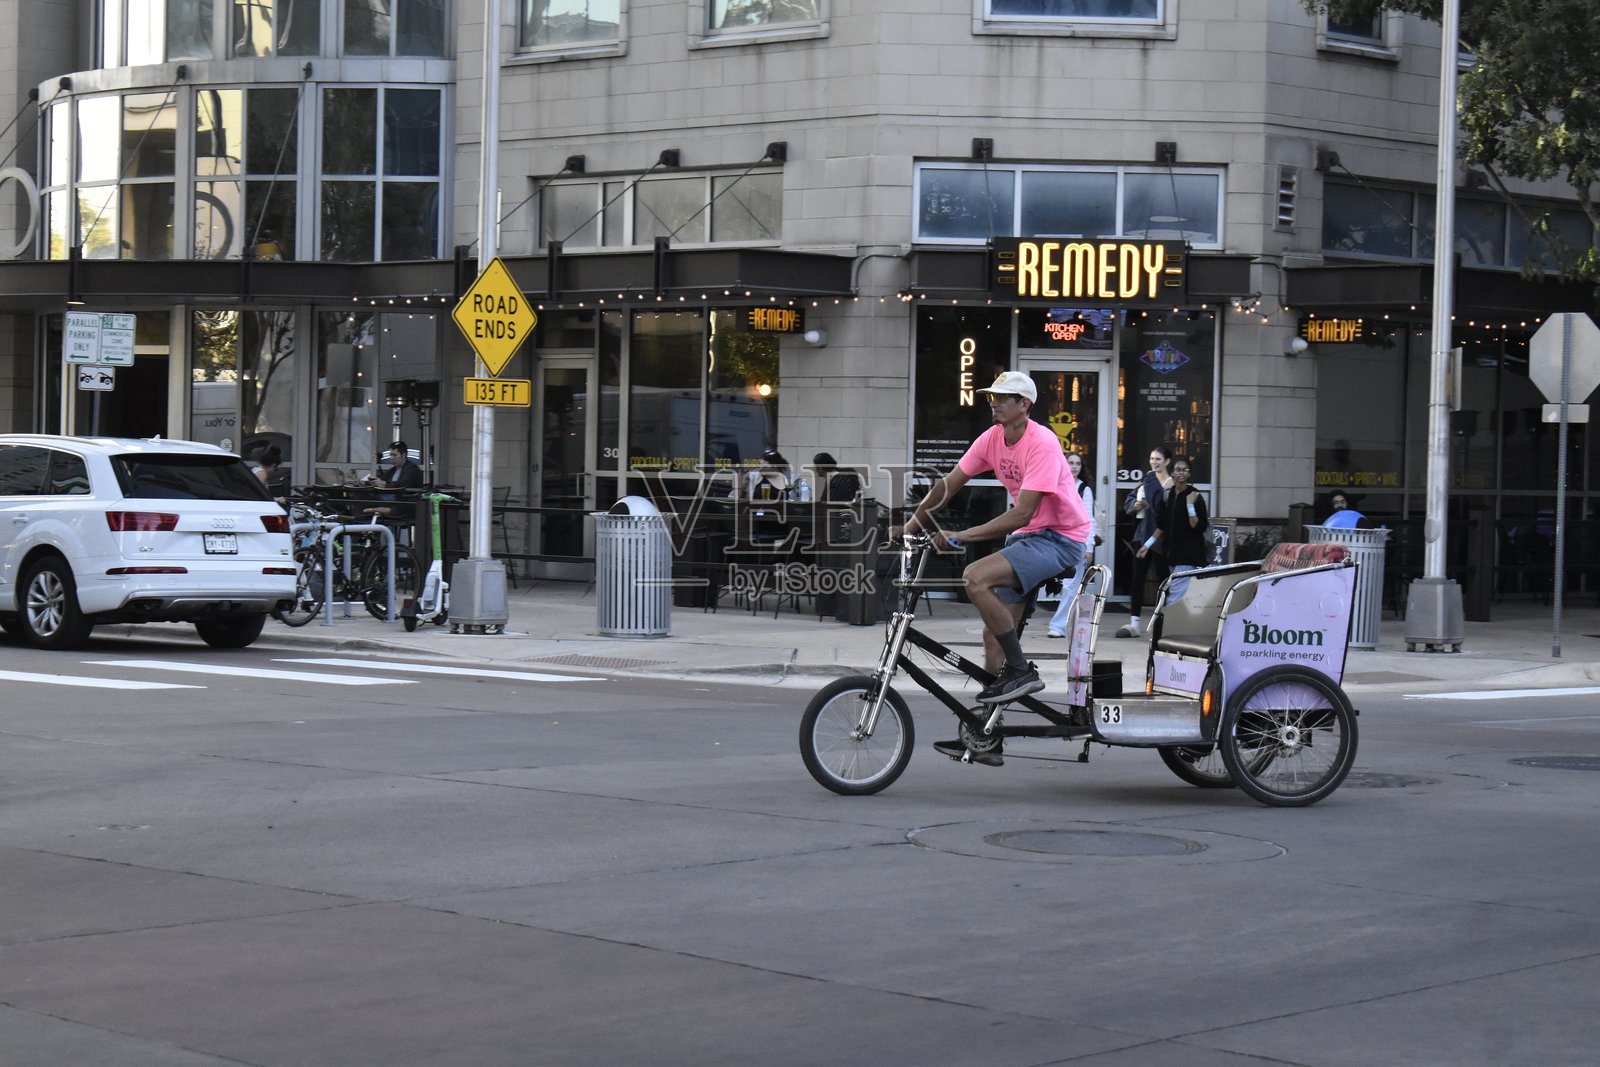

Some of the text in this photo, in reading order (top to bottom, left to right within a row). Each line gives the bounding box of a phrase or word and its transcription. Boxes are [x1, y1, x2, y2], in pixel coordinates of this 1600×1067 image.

[1017, 241, 1166, 298] REMEDY
[473, 294, 518, 315] ROAD
[67, 318, 99, 327] PARALLEL
[754, 308, 796, 331] REMEDY
[1044, 323, 1085, 332] KITCHEN
[68, 330, 96, 340] PARKING
[474, 319, 516, 339] ENDS
[1052, 331, 1077, 341] OPEN
[1308, 320, 1356, 341] REMEDY
[73, 342, 90, 351] ONLY
[960, 338, 976, 406] OPEN
[475, 383, 518, 402] 135 FT
[630, 456, 667, 471] COCKTAILS
[1117, 469, 1144, 481] 30
[1316, 471, 1349, 485] COCKTAILS
[1243, 621, 1323, 646] Bloom
[1240, 649, 1325, 662] sparkling energy
[1170, 666, 1187, 683] Bloom
[1102, 705, 1120, 723] 33
